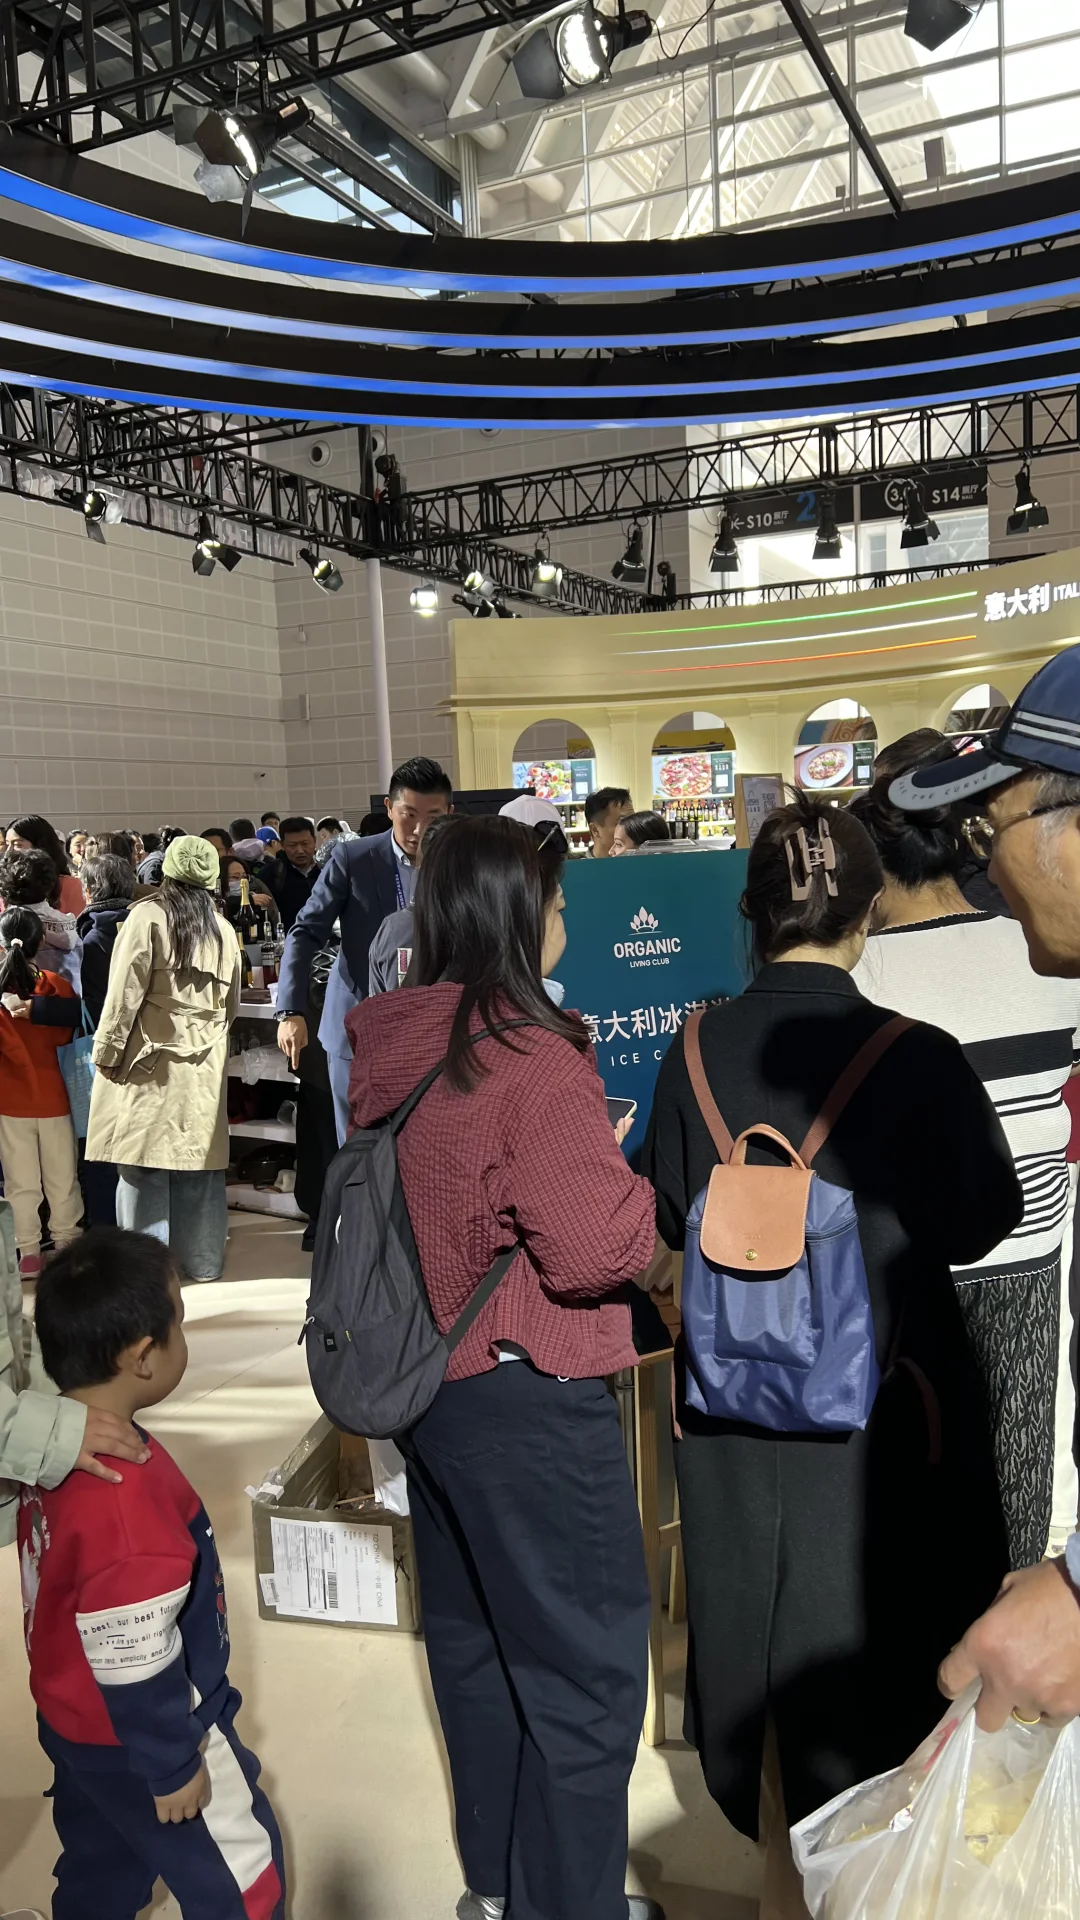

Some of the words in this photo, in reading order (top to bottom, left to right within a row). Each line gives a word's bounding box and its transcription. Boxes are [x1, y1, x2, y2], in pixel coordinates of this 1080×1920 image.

[932, 487, 960, 504] S14
[746, 513, 773, 529] S10
[984, 582, 1050, 622] 意大利
[944, 774, 988, 796] CURVE
[613, 937, 682, 959] ORGANIC
[629, 959, 651, 968] LIVING
[652, 957, 670, 967] CLUB
[582, 997, 730, 1044] 意大利冰
[611, 1052, 640, 1067] ICE
[134, 1611, 154, 1624] best
[151, 1649, 163, 1657] and
